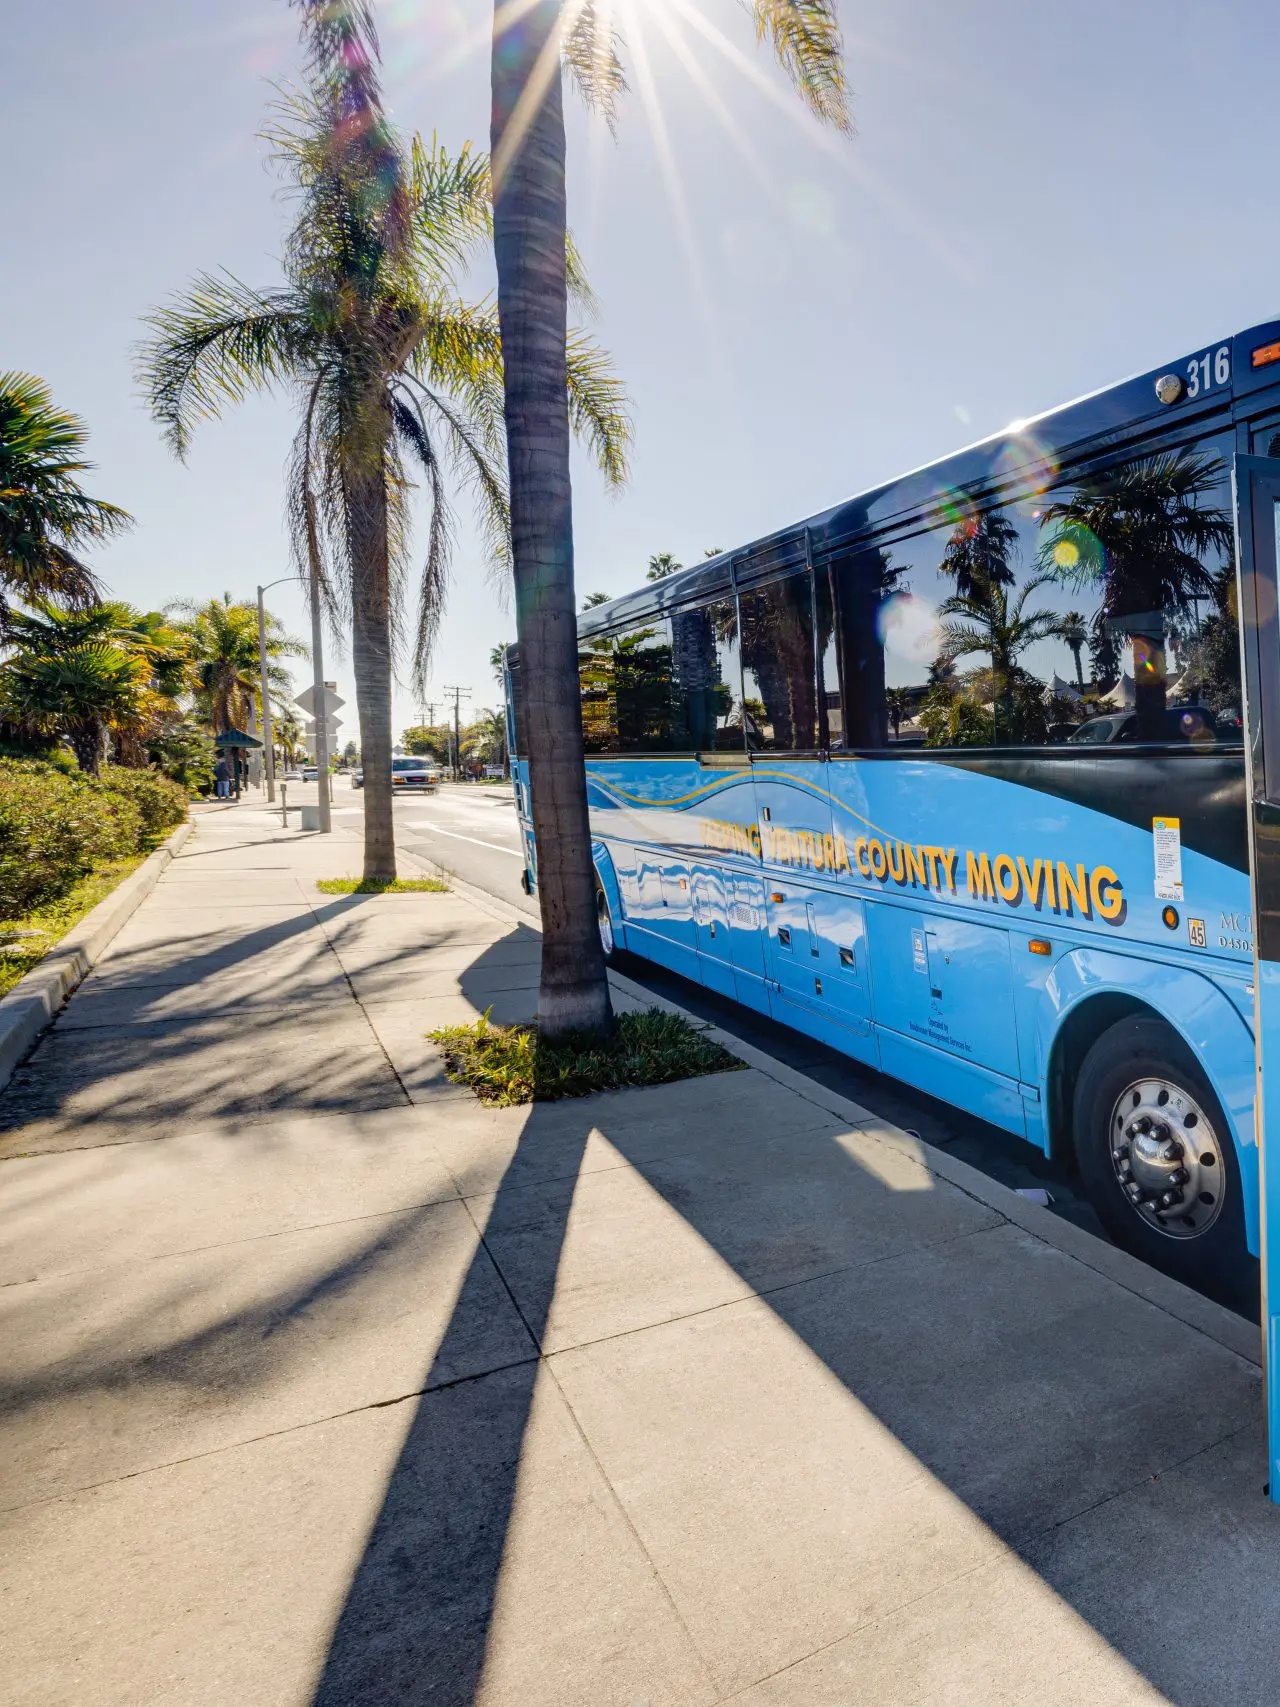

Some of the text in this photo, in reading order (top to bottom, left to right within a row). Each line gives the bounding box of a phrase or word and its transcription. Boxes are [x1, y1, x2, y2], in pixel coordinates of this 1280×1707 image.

[1186, 346, 1230, 398] 316
[764, 825, 852, 876] VENTURA
[855, 836, 958, 894] COUNTY
[966, 849, 1127, 926] MOVING
[1191, 926, 1204, 946] 45
